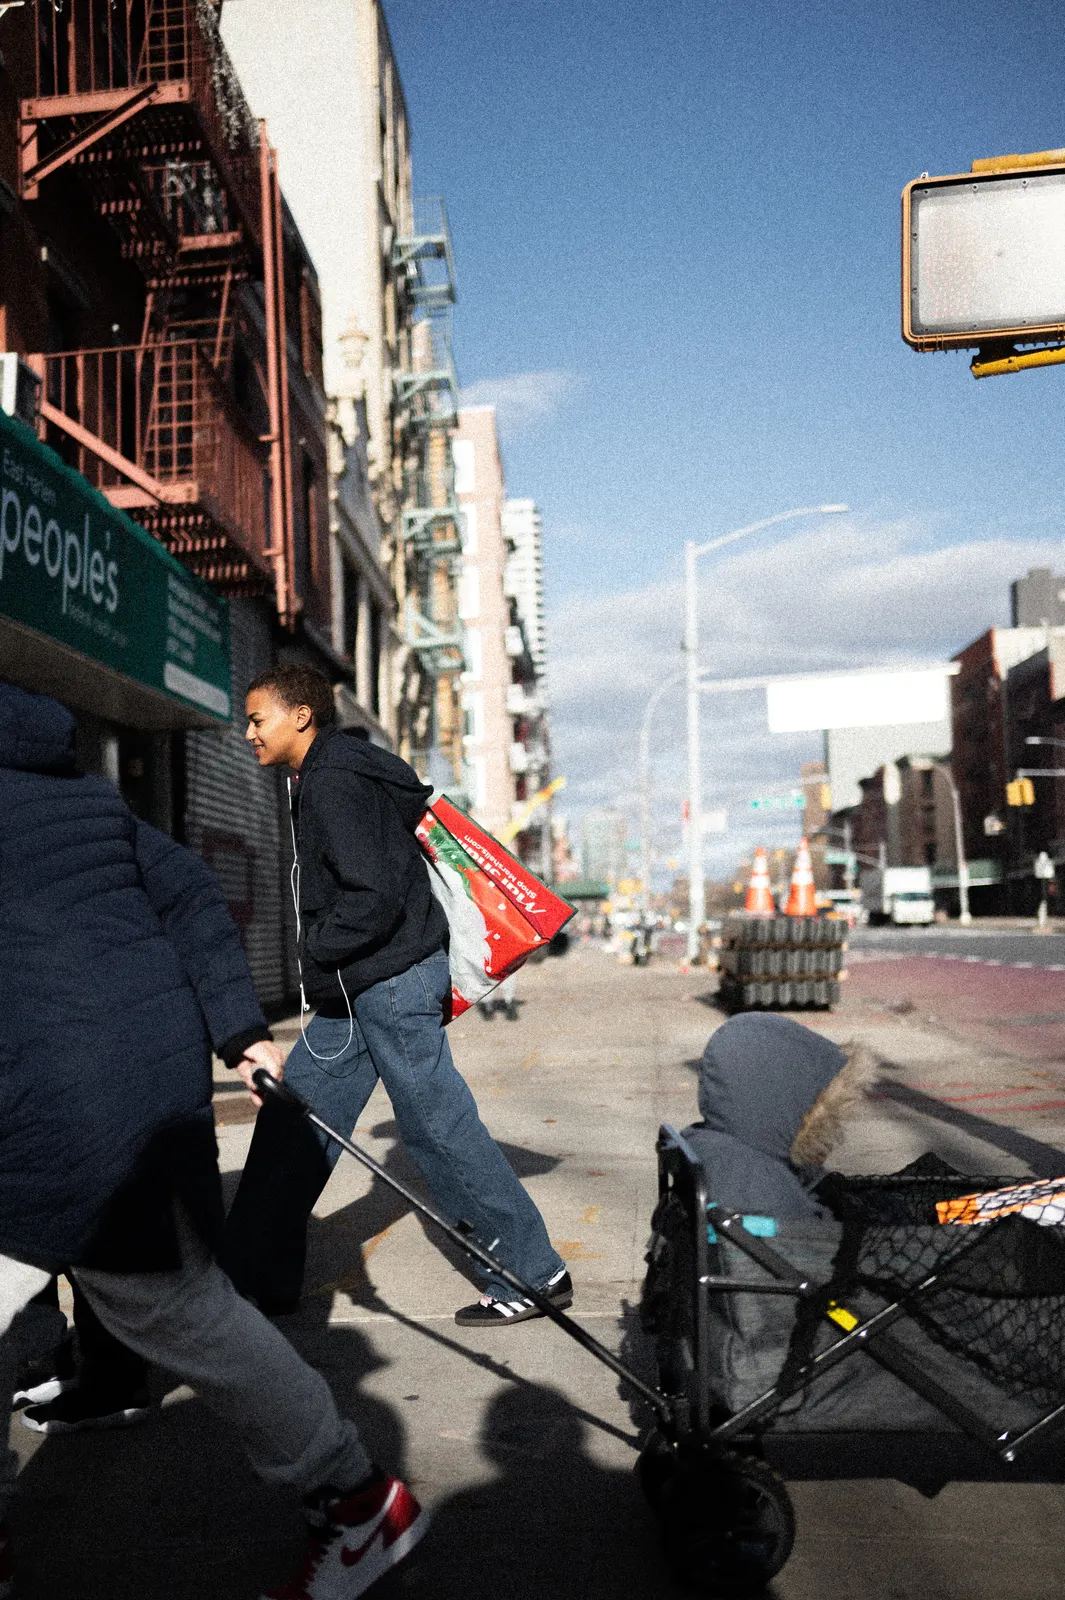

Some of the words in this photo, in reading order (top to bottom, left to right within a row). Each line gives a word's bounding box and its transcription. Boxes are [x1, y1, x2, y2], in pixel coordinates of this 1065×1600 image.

[0, 487, 118, 614] people's
[451, 832, 546, 914] Marsa
[464, 834, 517, 883] Marshalls.com
[517, 881, 537, 899] Shop
